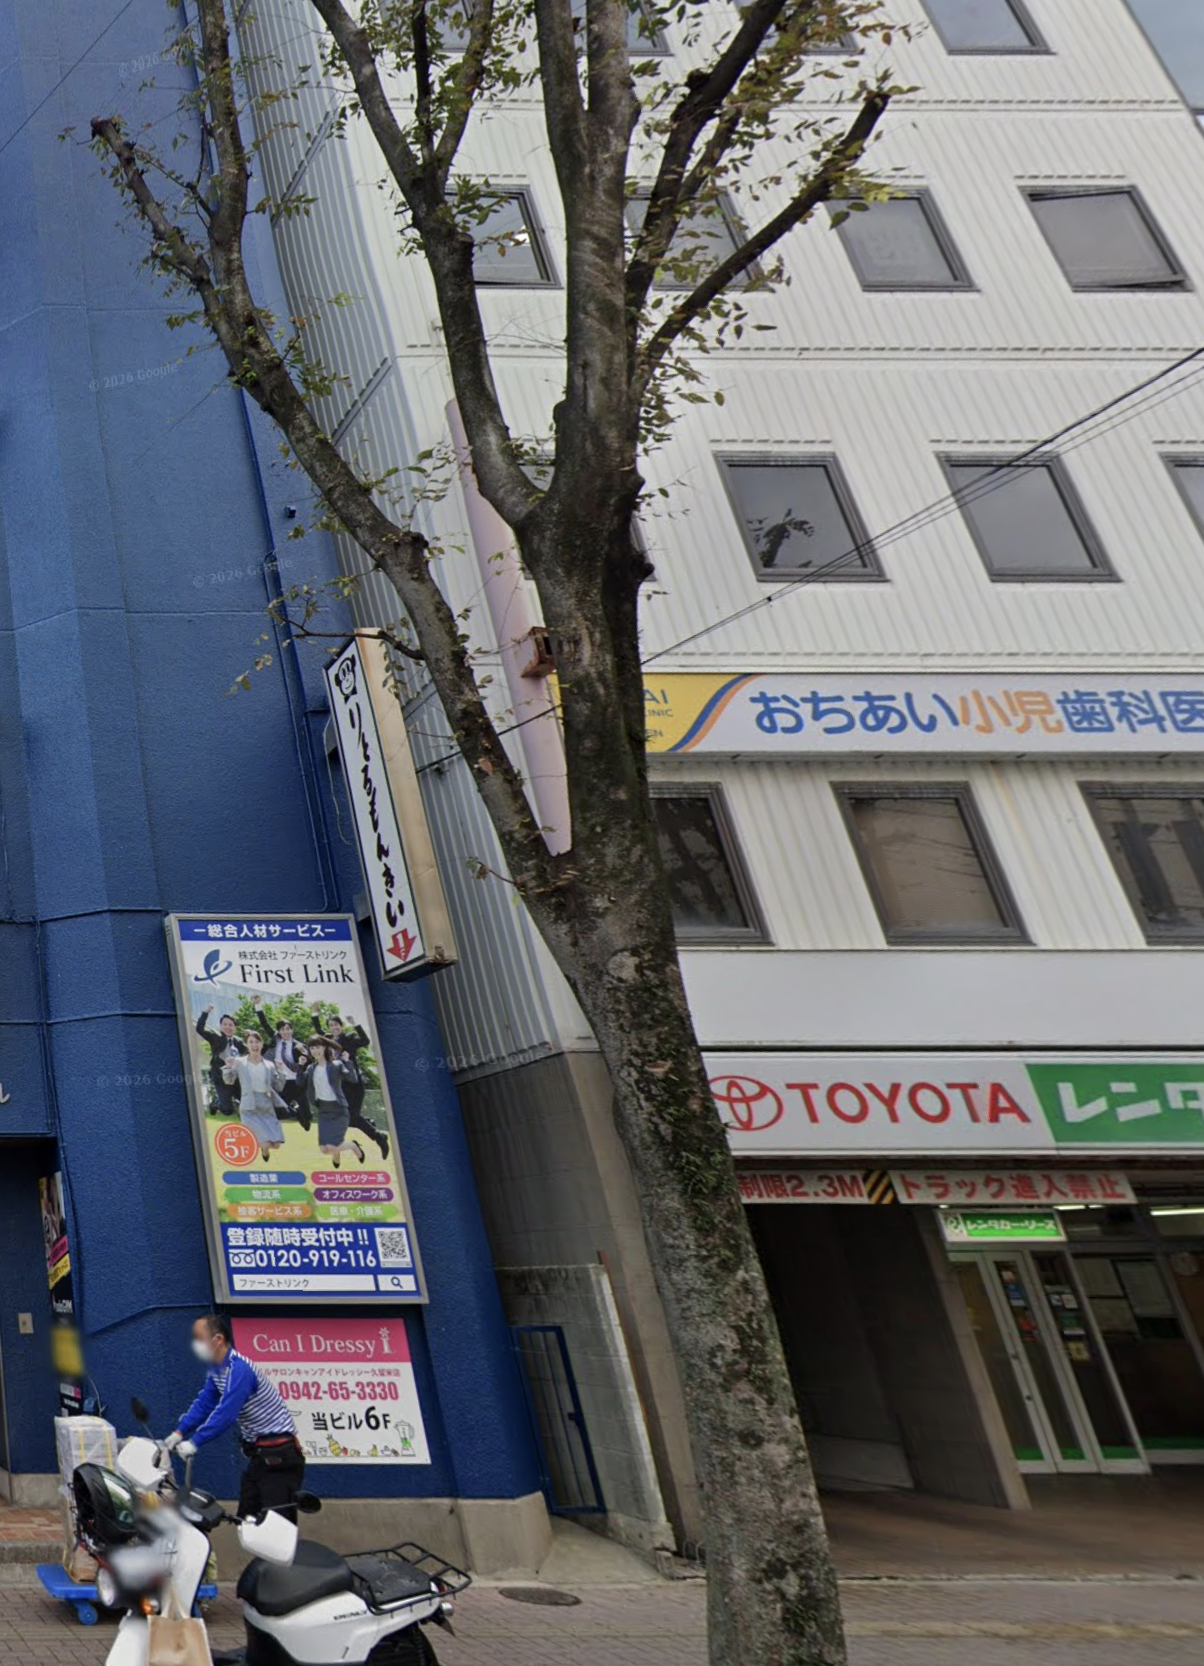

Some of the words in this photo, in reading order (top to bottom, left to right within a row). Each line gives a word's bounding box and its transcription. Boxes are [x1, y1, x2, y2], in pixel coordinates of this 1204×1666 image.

[748, 690, 1204, 734] おちあい小児歯科医
[238, 950, 277, 960] 株式会社
[280, 951, 347, 960] ファーストリンク
[240, 963, 295, 983] First
[304, 964, 354, 984] Link
[787, 1082, 1033, 1124] TOYOTA
[224, 1138, 250, 1159] 5F
[318, 1174, 386, 1183] コールセンター系
[900, 1174, 1127, 1199] トラック進入禁止
[322, 1190, 388, 1199] オフィスワーク系
[255, 1250, 377, 1268] 0120-919-116
[239, 1278, 310, 1288] ファーストリンク
[252, 1333, 290, 1353] Can
[294, 1334, 304, 1353] I
[311, 1335, 376, 1358] Dressy
[278, 1381, 399, 1400] 0942-65-3330
[311, 1406, 391, 1431] 当ビル6F
